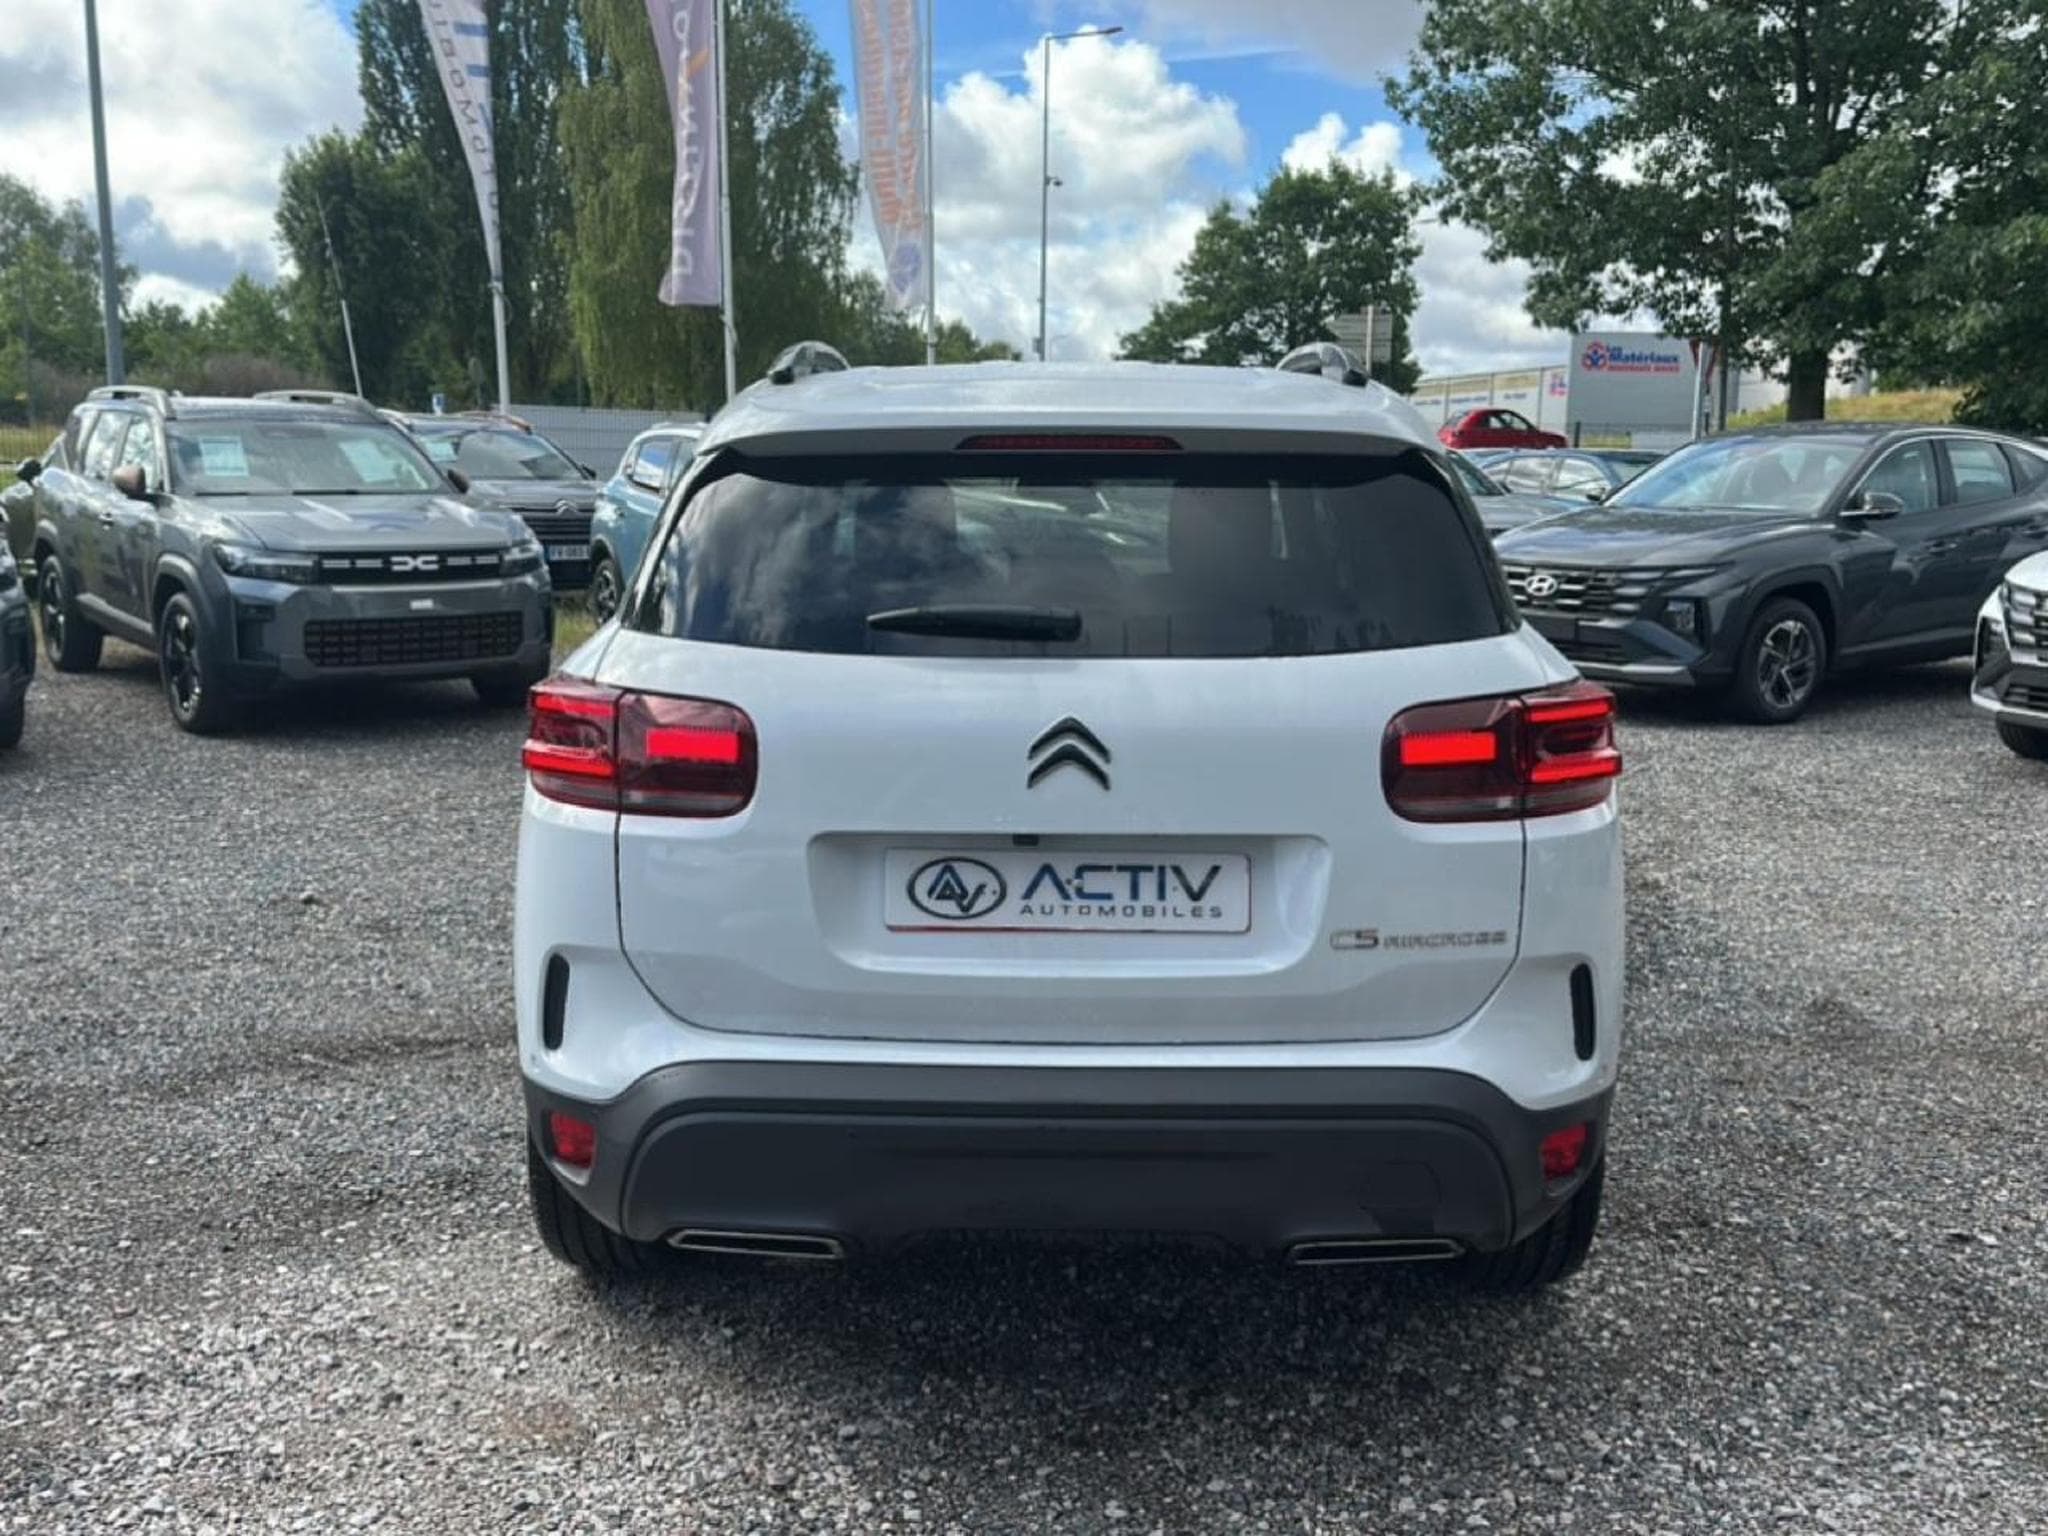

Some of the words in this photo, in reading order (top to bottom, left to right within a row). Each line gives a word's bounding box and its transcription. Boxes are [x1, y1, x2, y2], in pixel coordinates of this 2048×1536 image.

[1021, 862, 1223, 902] ACTIV
[1019, 904, 1224, 918] AUTOMOBILES
[1329, 928, 1380, 950] C5
[1384, 930, 1508, 949] AIRCROSS
